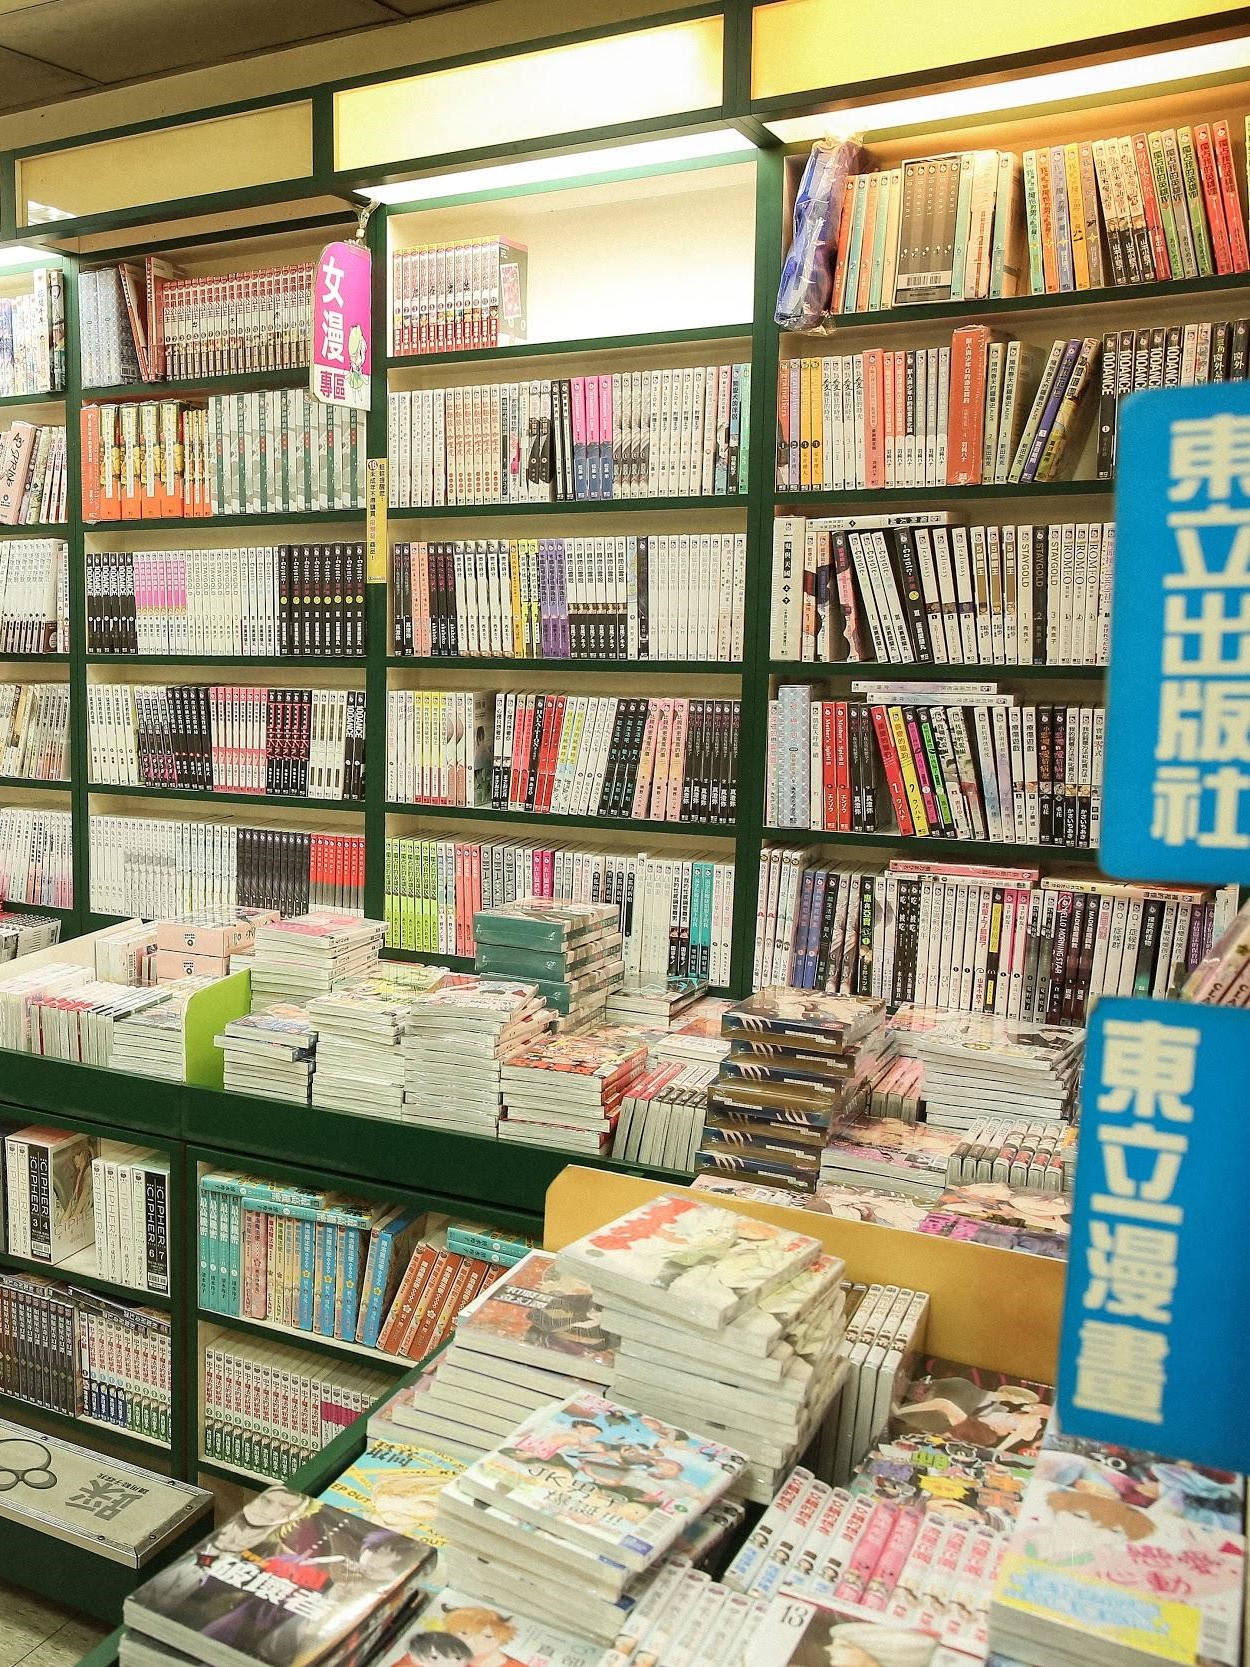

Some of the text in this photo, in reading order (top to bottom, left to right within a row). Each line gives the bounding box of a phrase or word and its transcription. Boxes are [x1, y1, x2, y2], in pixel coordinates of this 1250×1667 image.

[321, 255, 346, 364] 女漫
[319, 370, 346, 401] 專區
[1102, 351, 1116, 396] 10DANCE
[1118, 350, 1132, 394] 10DANCE
[1148, 347, 1163, 390] 10DANC
[1165, 345, 1180, 389] 10DANC
[1021, 544, 1030, 588] STAYGOLD
[1035, 544, 1044, 587] STAYGOLD
[1050, 541, 1059, 586] STAYGOLD
[1062, 544, 1073, 585] ROMEO
[1075, 544, 1086, 585] ROMEO
[1087, 544, 1099, 584] ROMEO
[1151, 412, 1250, 850] 東立出版社
[30, 1157, 40, 1214] CIPHER
[40, 1160, 49, 1217] CIPHER
[146, 1186, 155, 1243] CIPHER
[156, 1188, 165, 1246] CIPHER
[1072, 1019, 1201, 1426] 東立漫畫
[65, 1478, 145, 1521] 踩
[779, 1605, 806, 1627] 13
